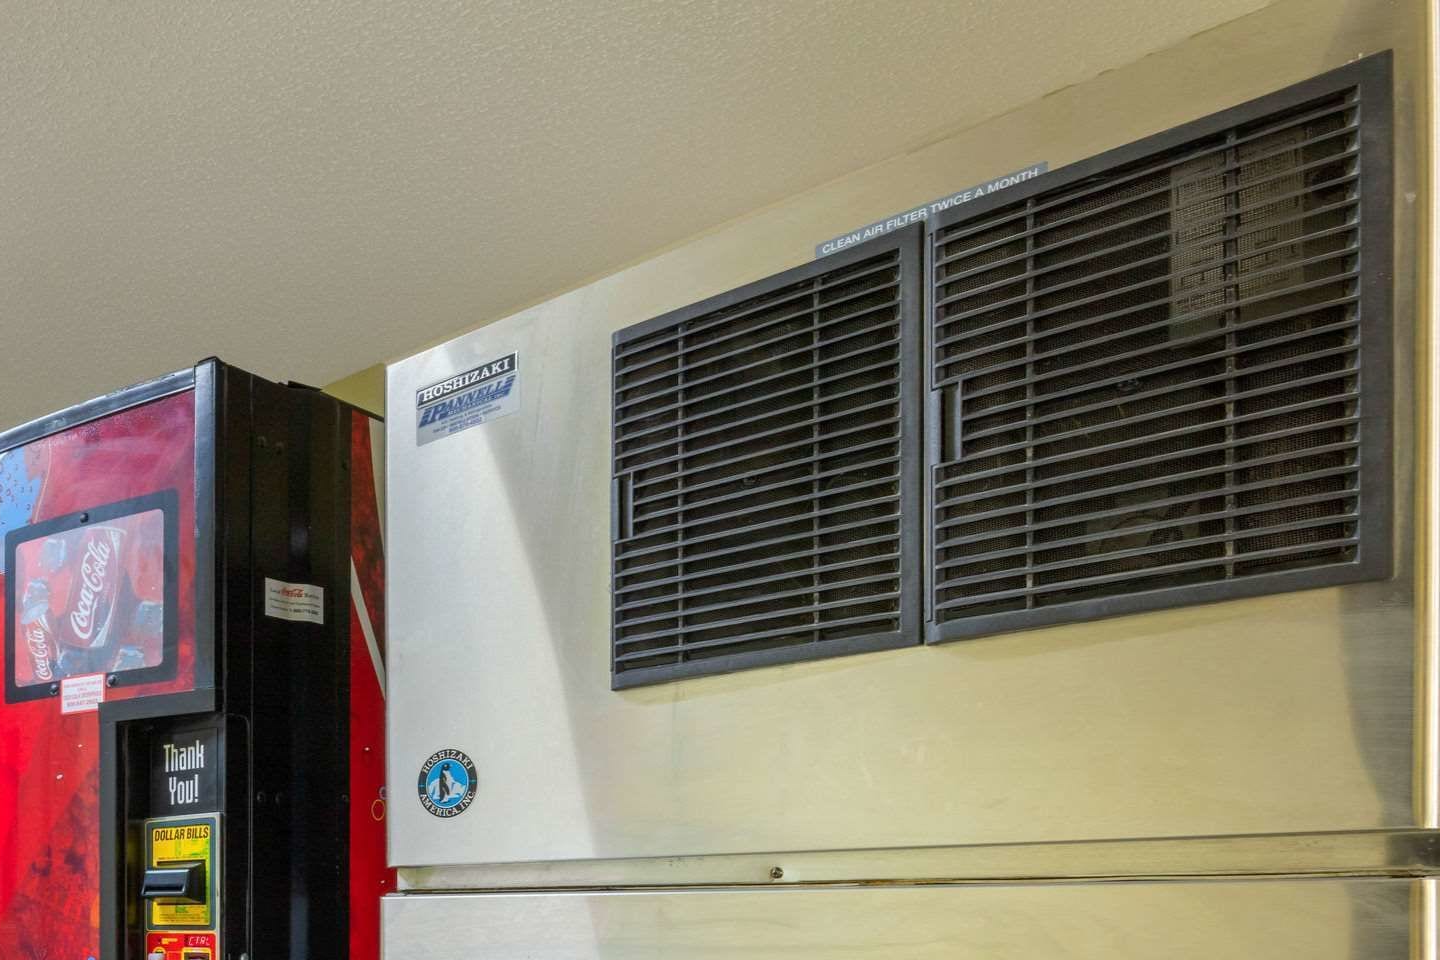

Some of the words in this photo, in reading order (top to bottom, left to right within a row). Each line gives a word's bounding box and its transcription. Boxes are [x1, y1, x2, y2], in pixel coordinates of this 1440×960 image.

[822, 233, 861, 254] CLEAN
[863, 224, 884, 238] AIR
[886, 207, 928, 235] FILTER
[930, 192, 972, 214] TWICE
[974, 188, 985, 199] A
[987, 167, 1038, 194] MONTH
[422, 357, 510, 402] HOSHIZAKI
[163, 739, 205, 773] Thank
[422, 750, 473, 774] HOSHIZAKI
[168, 774, 199, 806] You!
[154, 828, 186, 842] DOLLAR
[186, 826, 209, 840] BILLS
